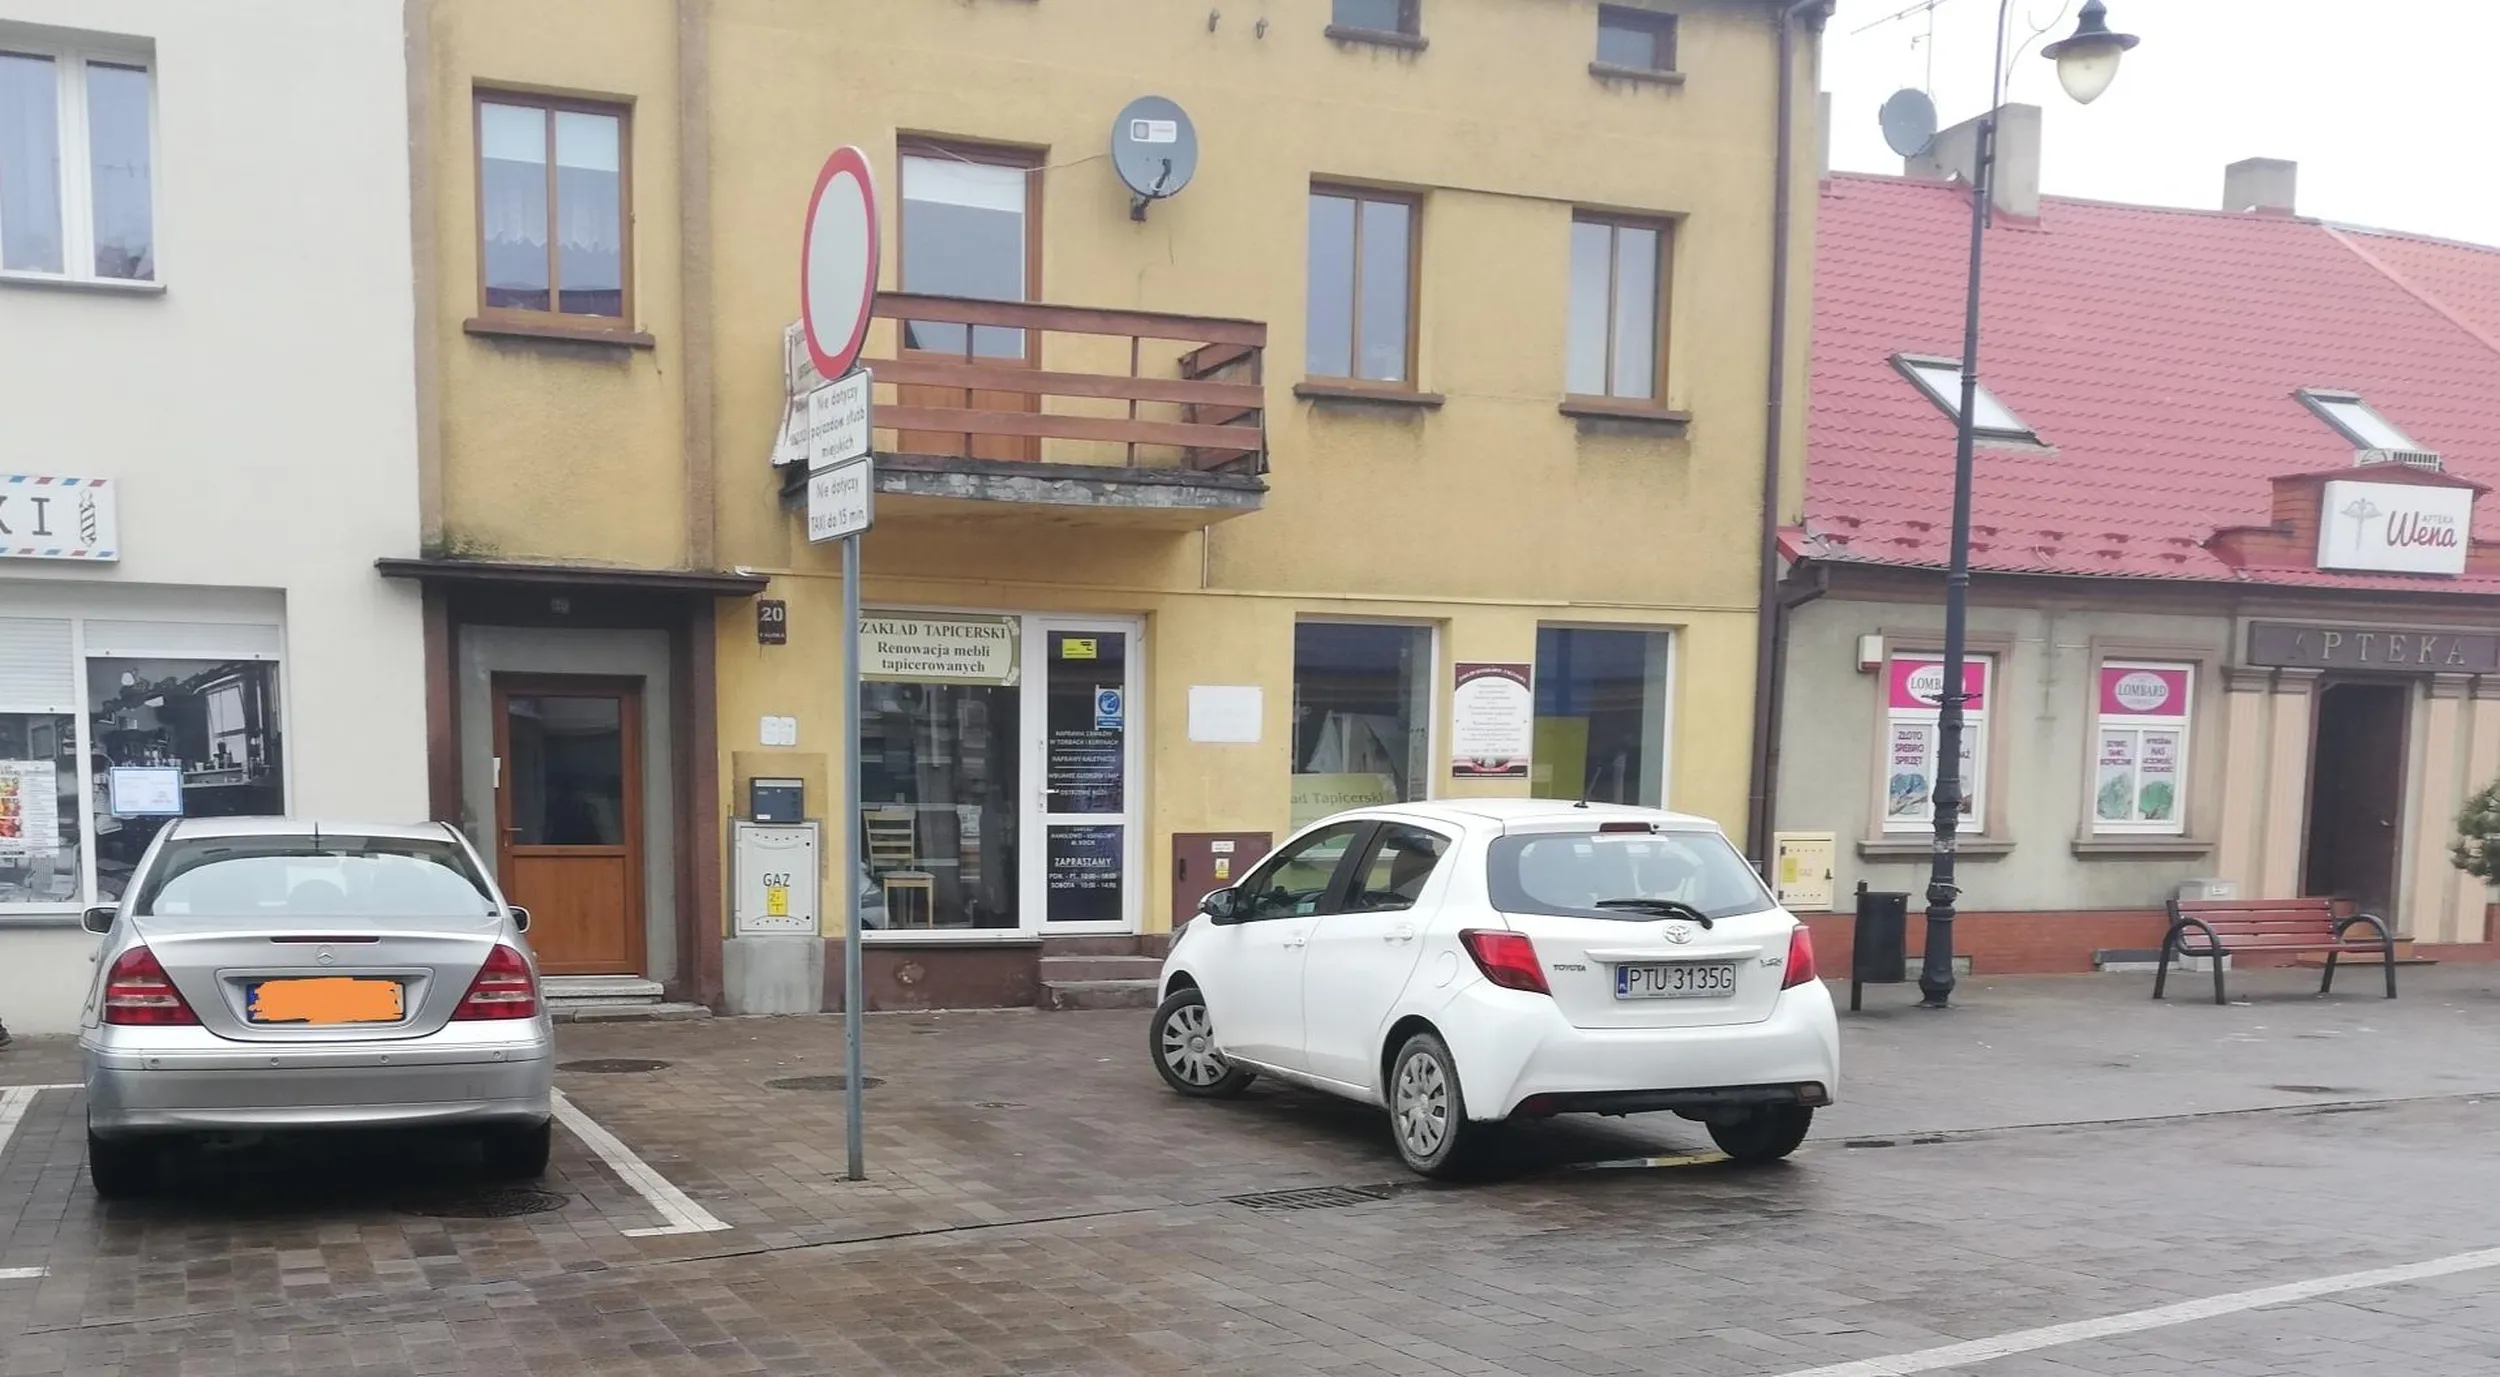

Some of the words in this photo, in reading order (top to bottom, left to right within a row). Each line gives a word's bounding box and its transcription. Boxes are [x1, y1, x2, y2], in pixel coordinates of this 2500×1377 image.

[831, 476, 859, 497] dotyczy
[2386, 510, 2458, 549] Wena
[760, 606, 784, 622] 20
[923, 624, 1006, 639] TAPICERSKI
[877, 641, 950, 658] Renowacja
[954, 645, 990, 657] mebli
[882, 658, 985, 674] tapicerowanych
[1910, 677, 1945, 691] LOMB
[2117, 684, 2168, 698] LOMBARD
[1054, 857, 1112, 867] ZAPRASZAMY
[763, 872, 791, 887] GAZ
[1553, 963, 1587, 972] TOYOTA
[1629, 967, 1667, 991] PTU
[1673, 966, 1733, 989] 3135G
